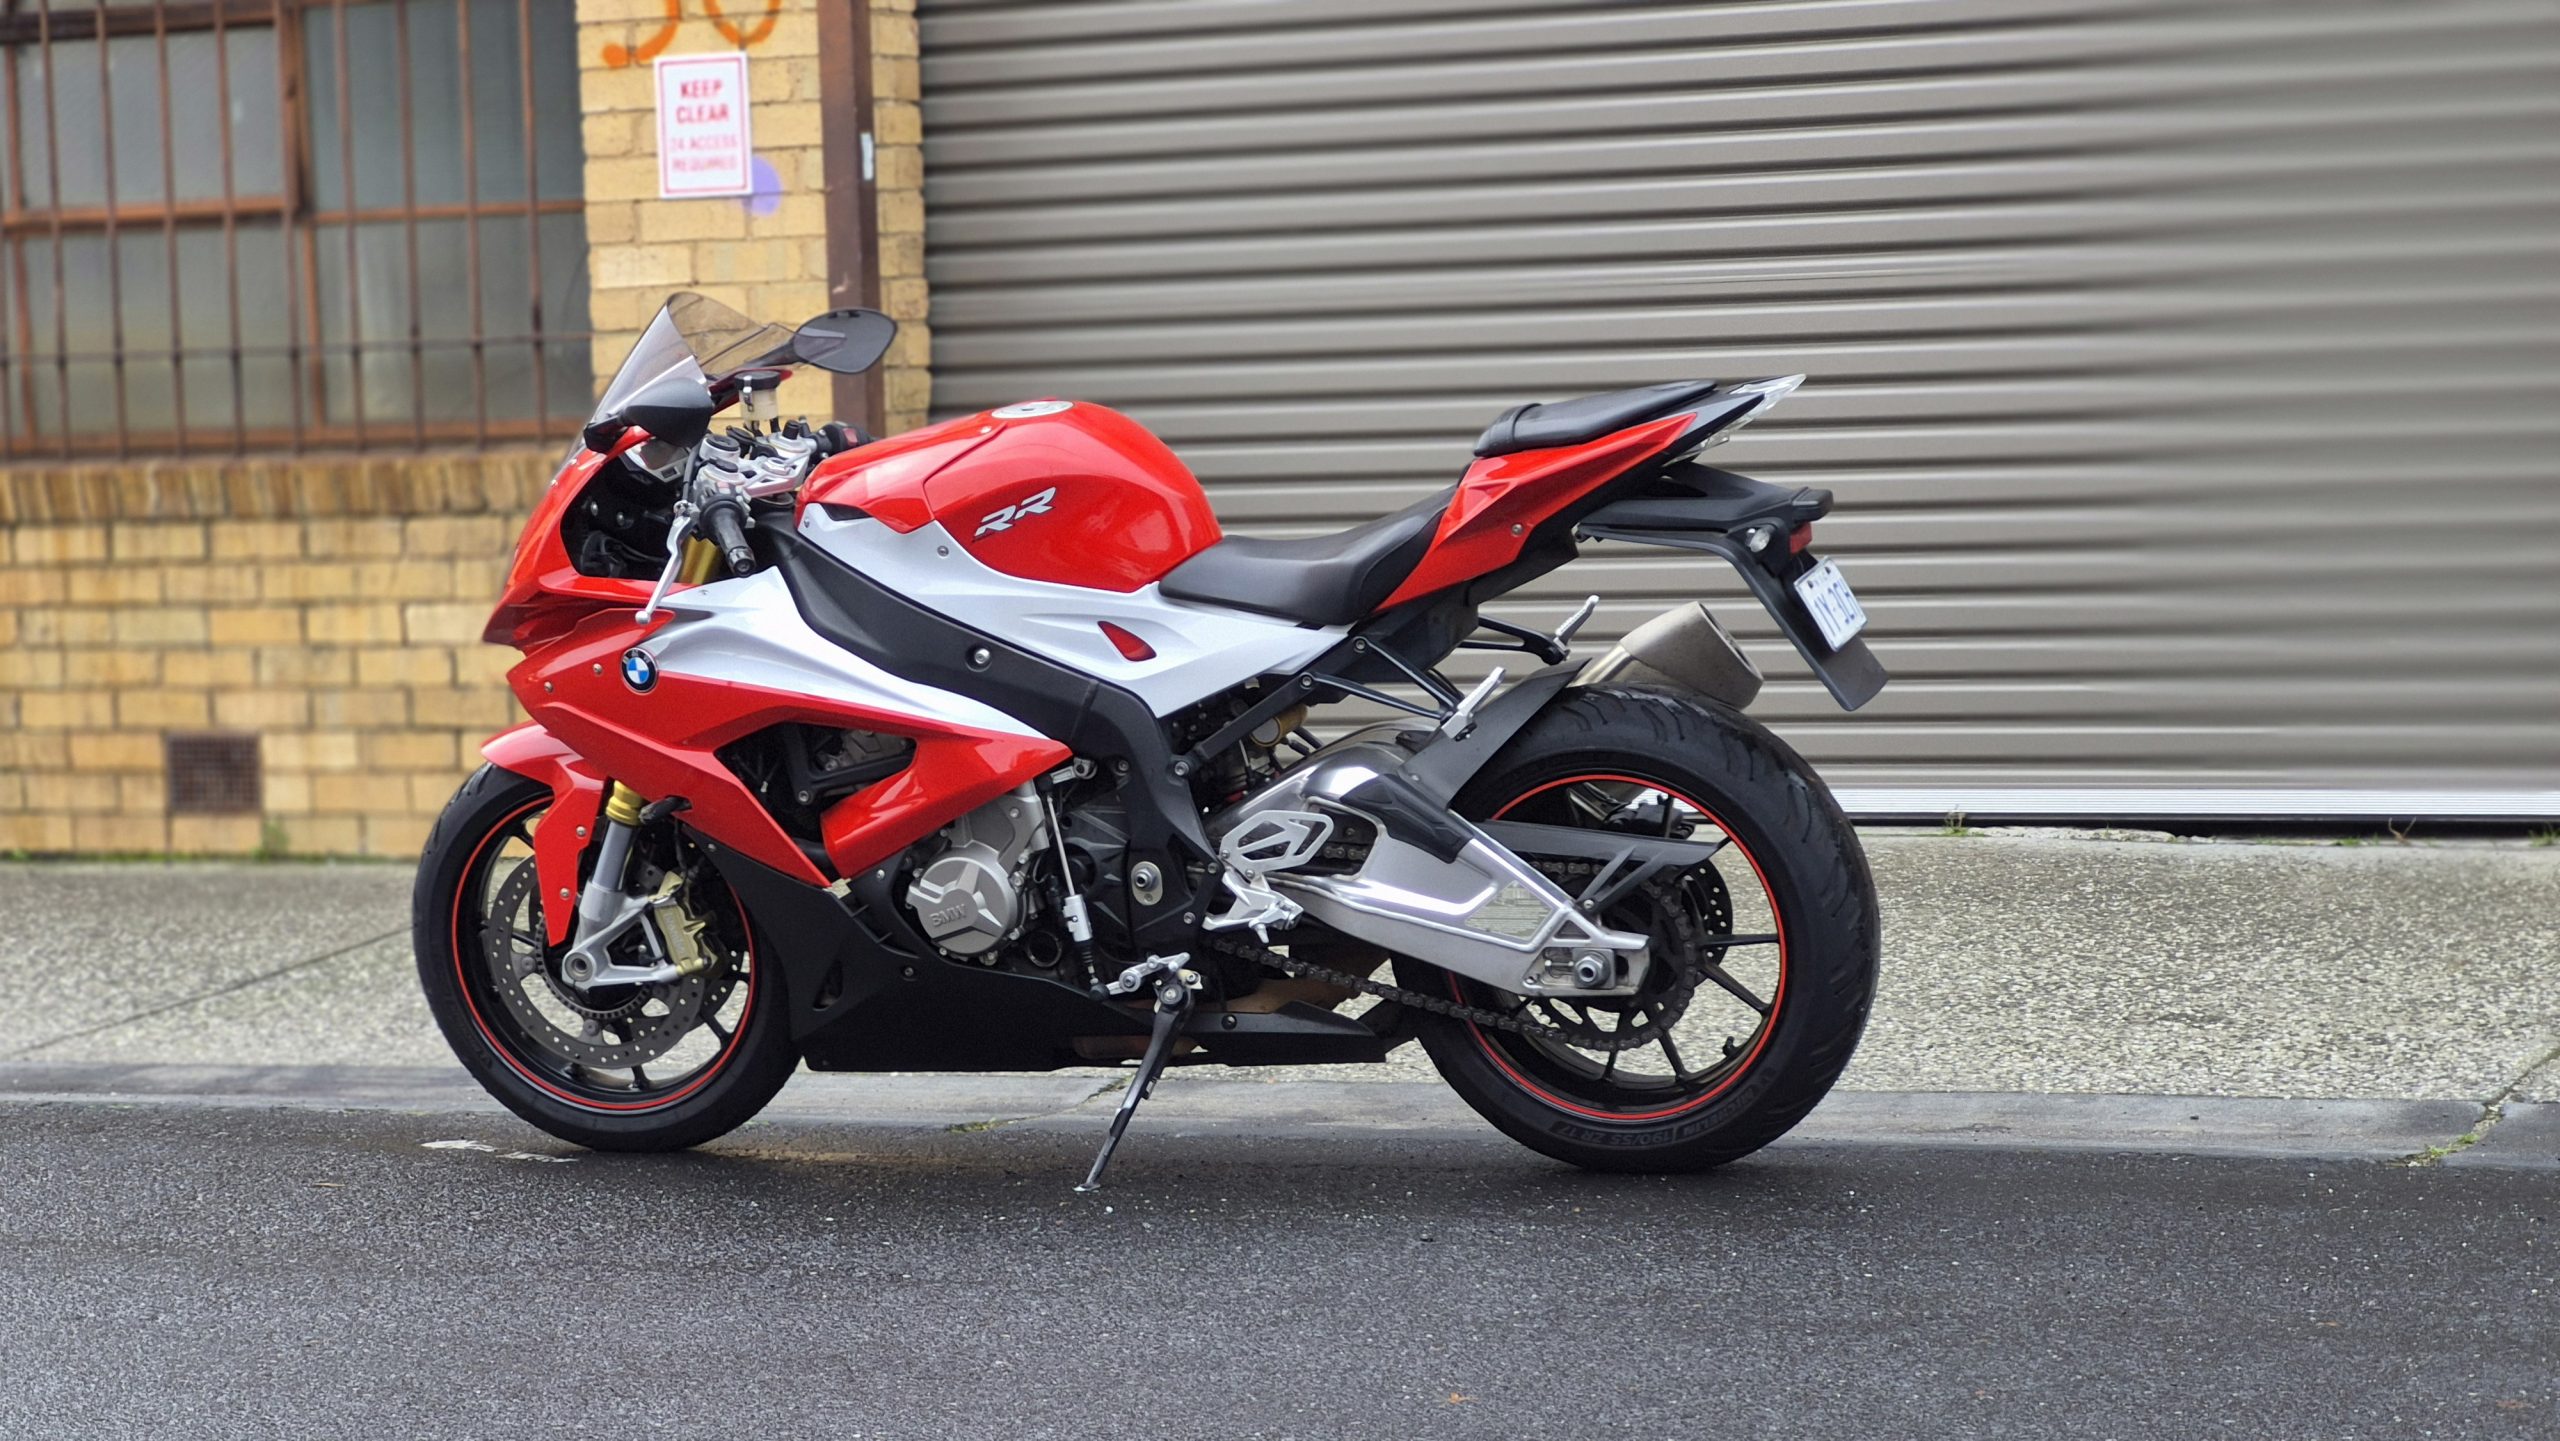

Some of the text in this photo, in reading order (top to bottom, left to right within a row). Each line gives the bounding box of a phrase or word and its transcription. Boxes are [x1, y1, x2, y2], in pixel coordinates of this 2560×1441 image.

[681, 80, 722, 98] KEEP
[676, 104, 729, 123] CLEAR
[690, 134, 737, 150] ACCESS
[672, 156, 737, 172] REQUIRED
[974, 486, 1056, 537] RR
[930, 903, 967, 927] BMW
[1560, 1089, 1753, 1147] MICHELIN 190/55 ZR 17
